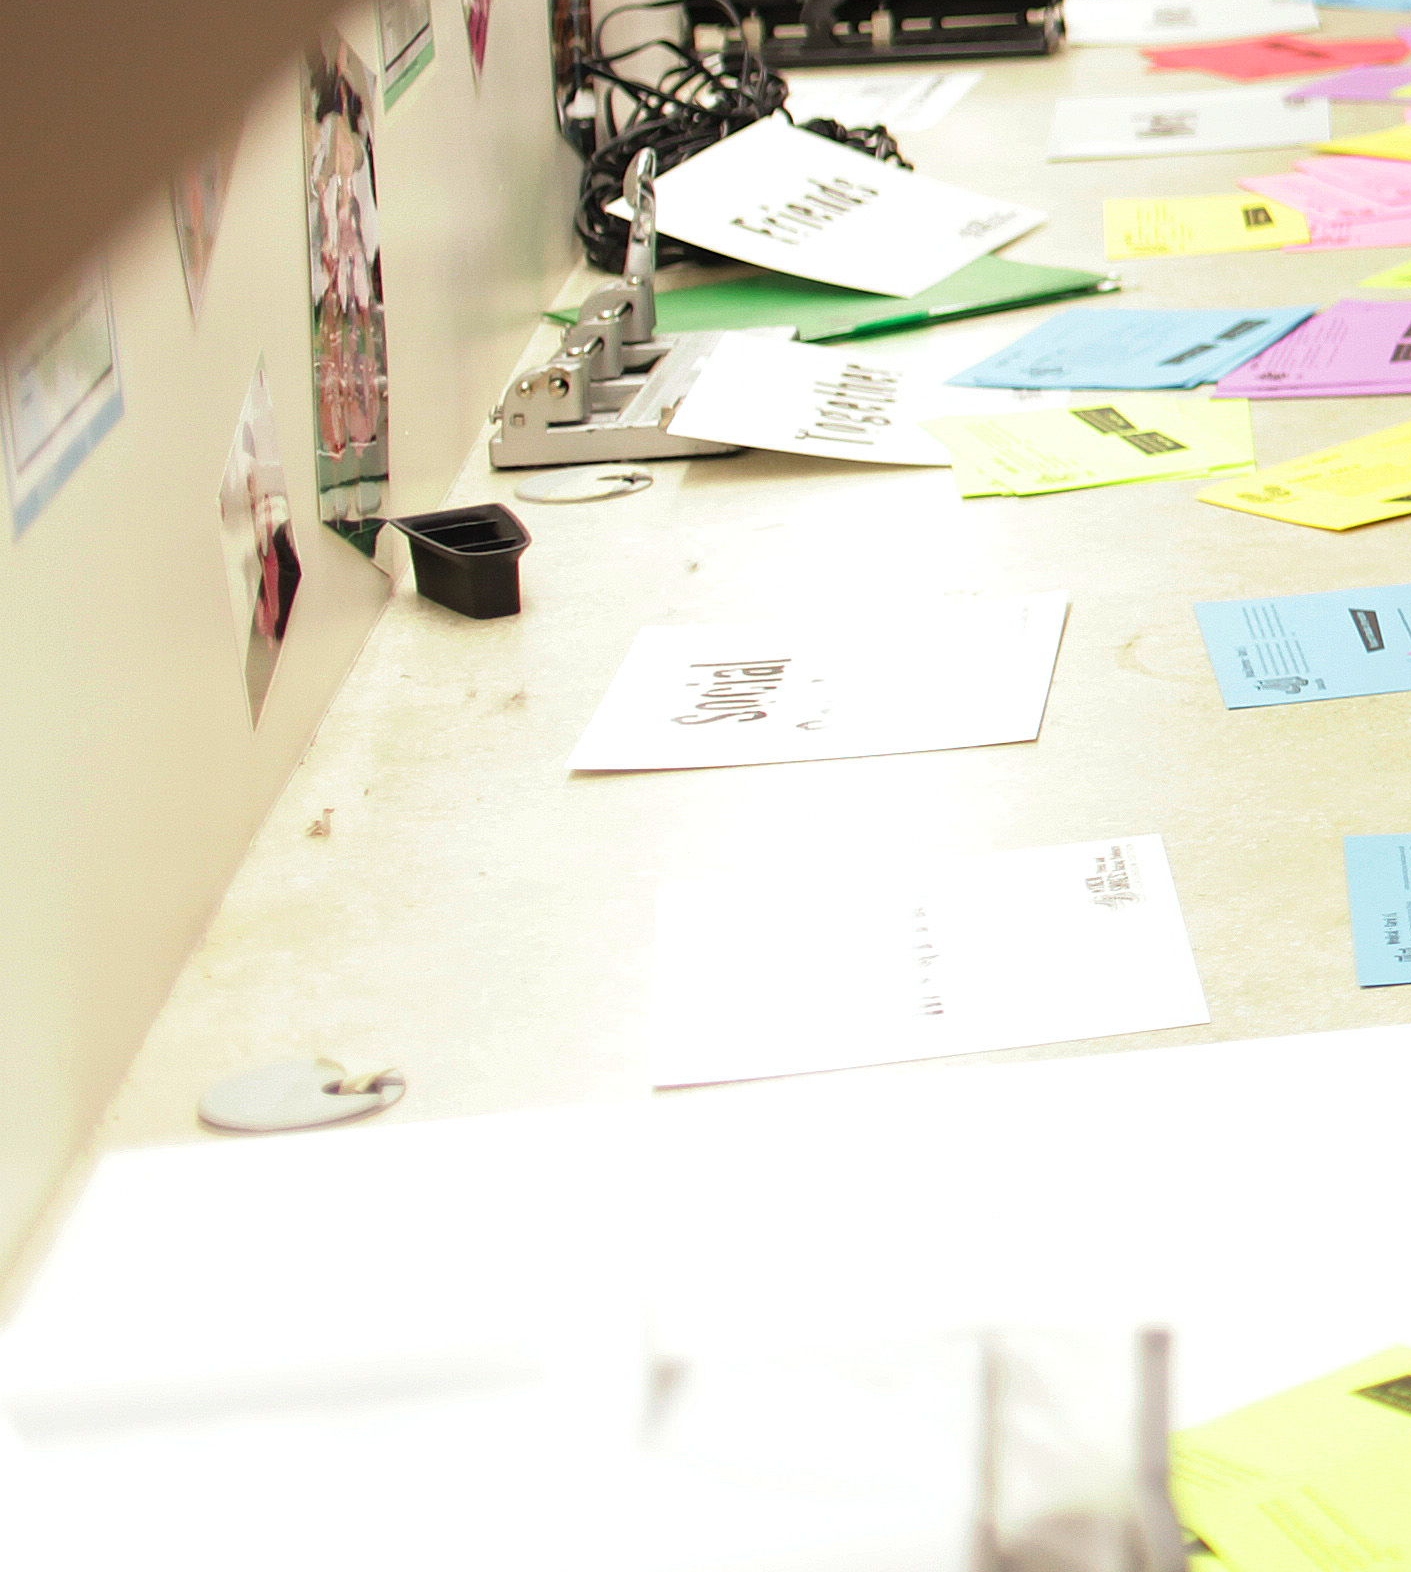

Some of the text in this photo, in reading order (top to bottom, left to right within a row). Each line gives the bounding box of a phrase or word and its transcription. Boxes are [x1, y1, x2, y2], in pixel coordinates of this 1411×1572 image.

[730, 178, 878, 244] Friends
[795, 363, 898, 445] Together
[671, 659, 792, 725] Social
